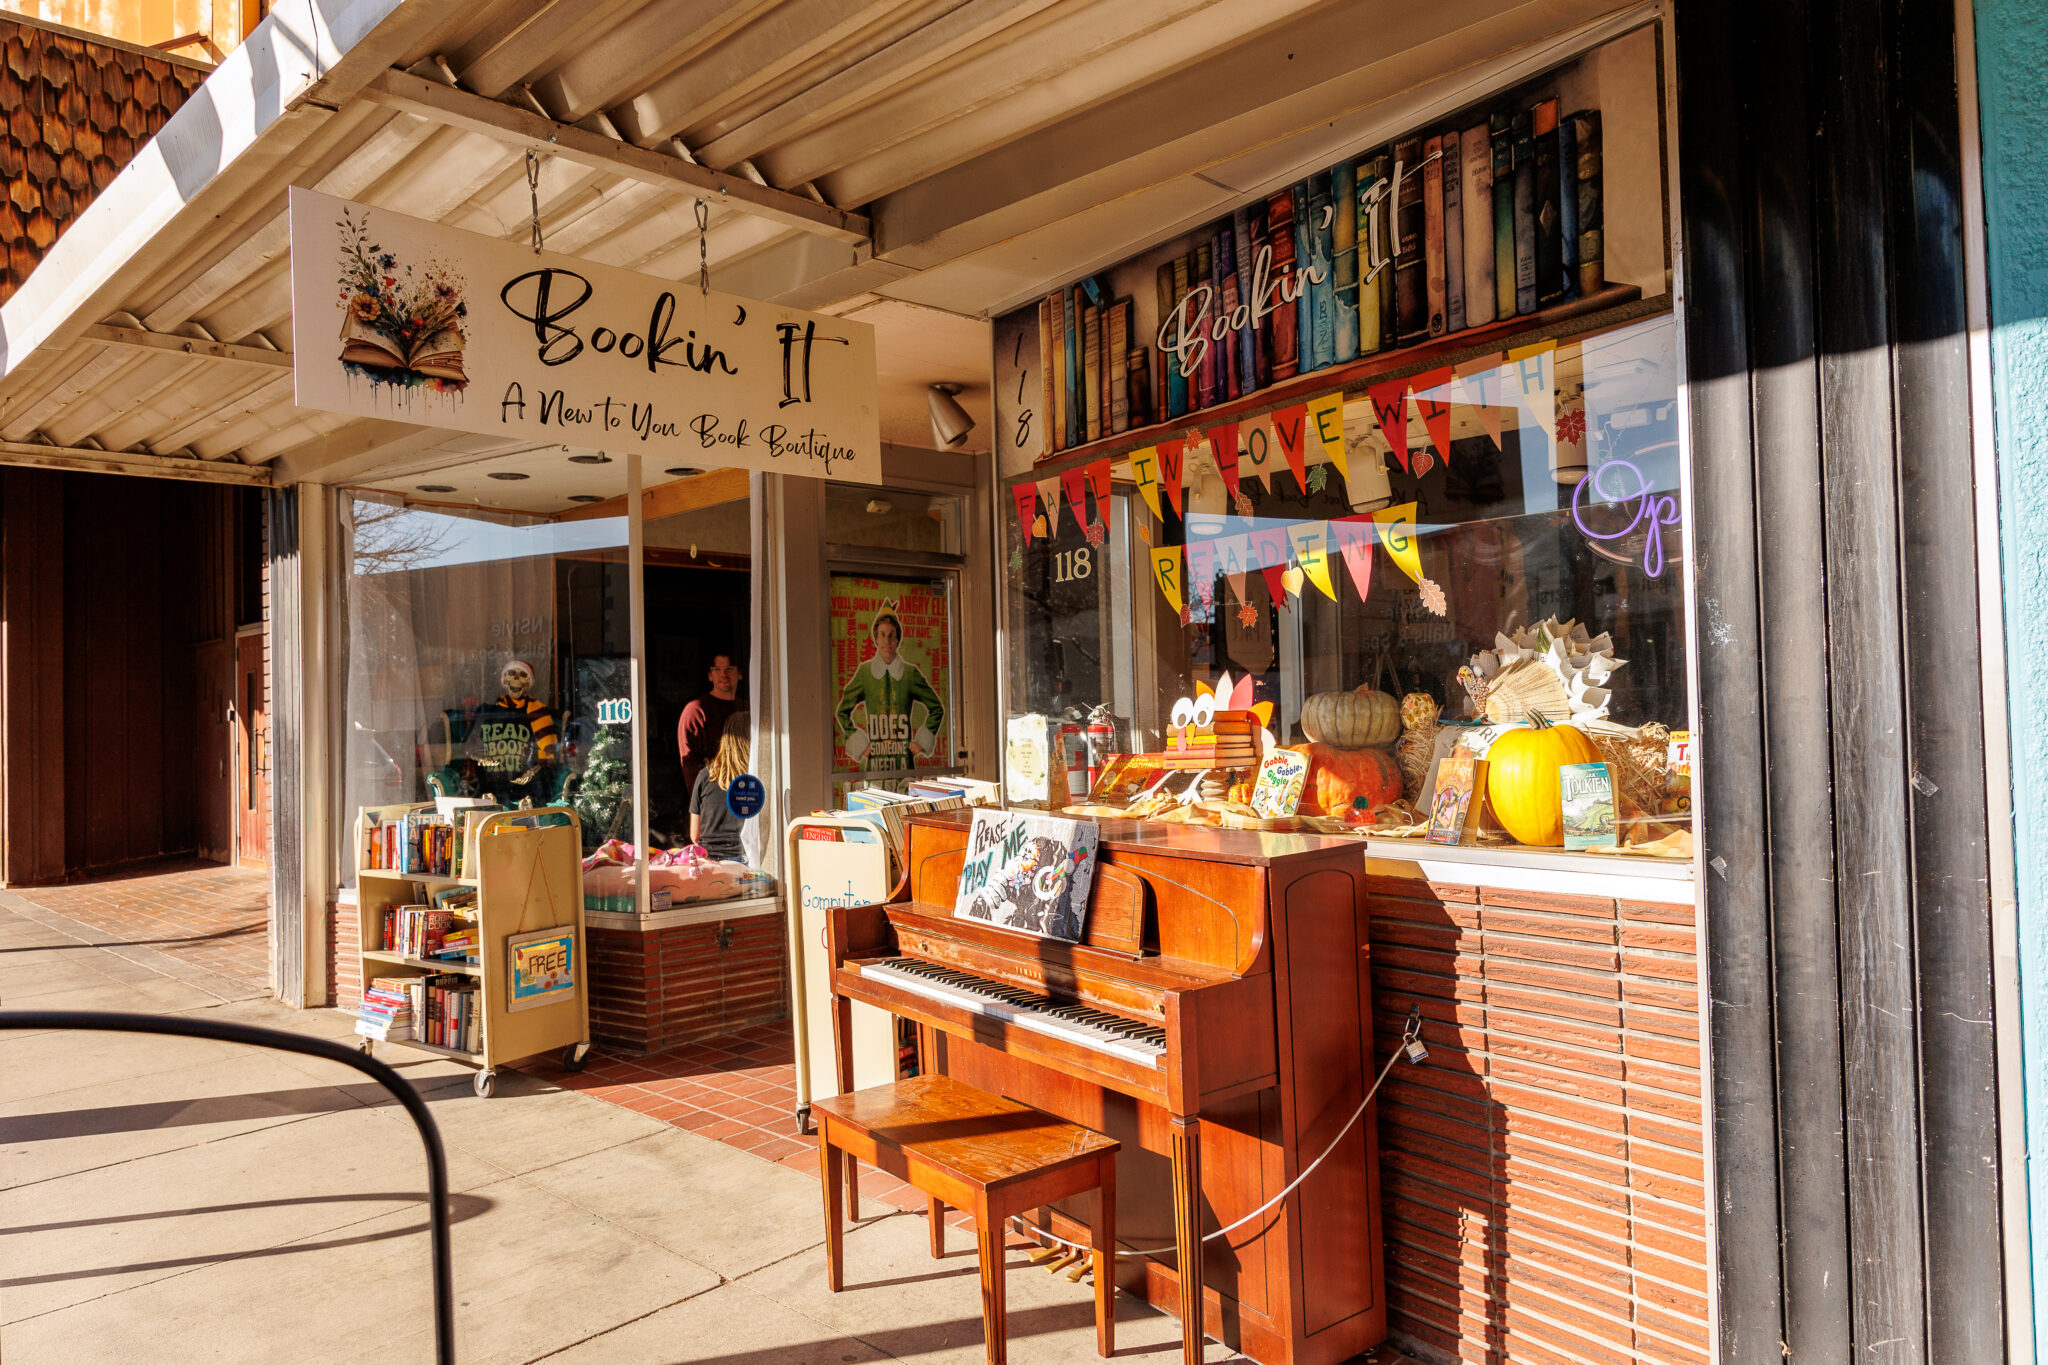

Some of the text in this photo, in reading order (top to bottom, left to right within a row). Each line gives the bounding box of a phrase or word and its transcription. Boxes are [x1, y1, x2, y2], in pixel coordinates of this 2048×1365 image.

[500, 267, 748, 375] Bookin'
[501, 381, 856, 475] A New to You Book Boutique
[1020, 354, 1544, 524] FALL IN LOVE WITH
[1572, 460, 1682, 578] Op
[1055, 547, 1092, 583] 118
[1158, 516, 1408, 592] READING
[598, 698, 632, 726] 116
[481, 723, 530, 742] READ
[869, 714, 909, 741] DOES
[870, 741, 908, 756] SOMEONE
[1264, 755, 1288, 768] Gobble,
[870, 757, 896, 772] NEED
[900, 757, 908, 771] A
[1267, 770, 1286, 787] Giggle
[1563, 776, 1610, 802] TOLKIEN
[408, 815, 444, 828] STEVE
[806, 832, 832, 842] ENGLISH
[974, 818, 1008, 856] PLEASE
[962, 820, 1028, 896] PLAY ME
[801, 880, 871, 910] Computer
[428, 922, 452, 930] COOK
[529, 950, 566, 975] FREE
